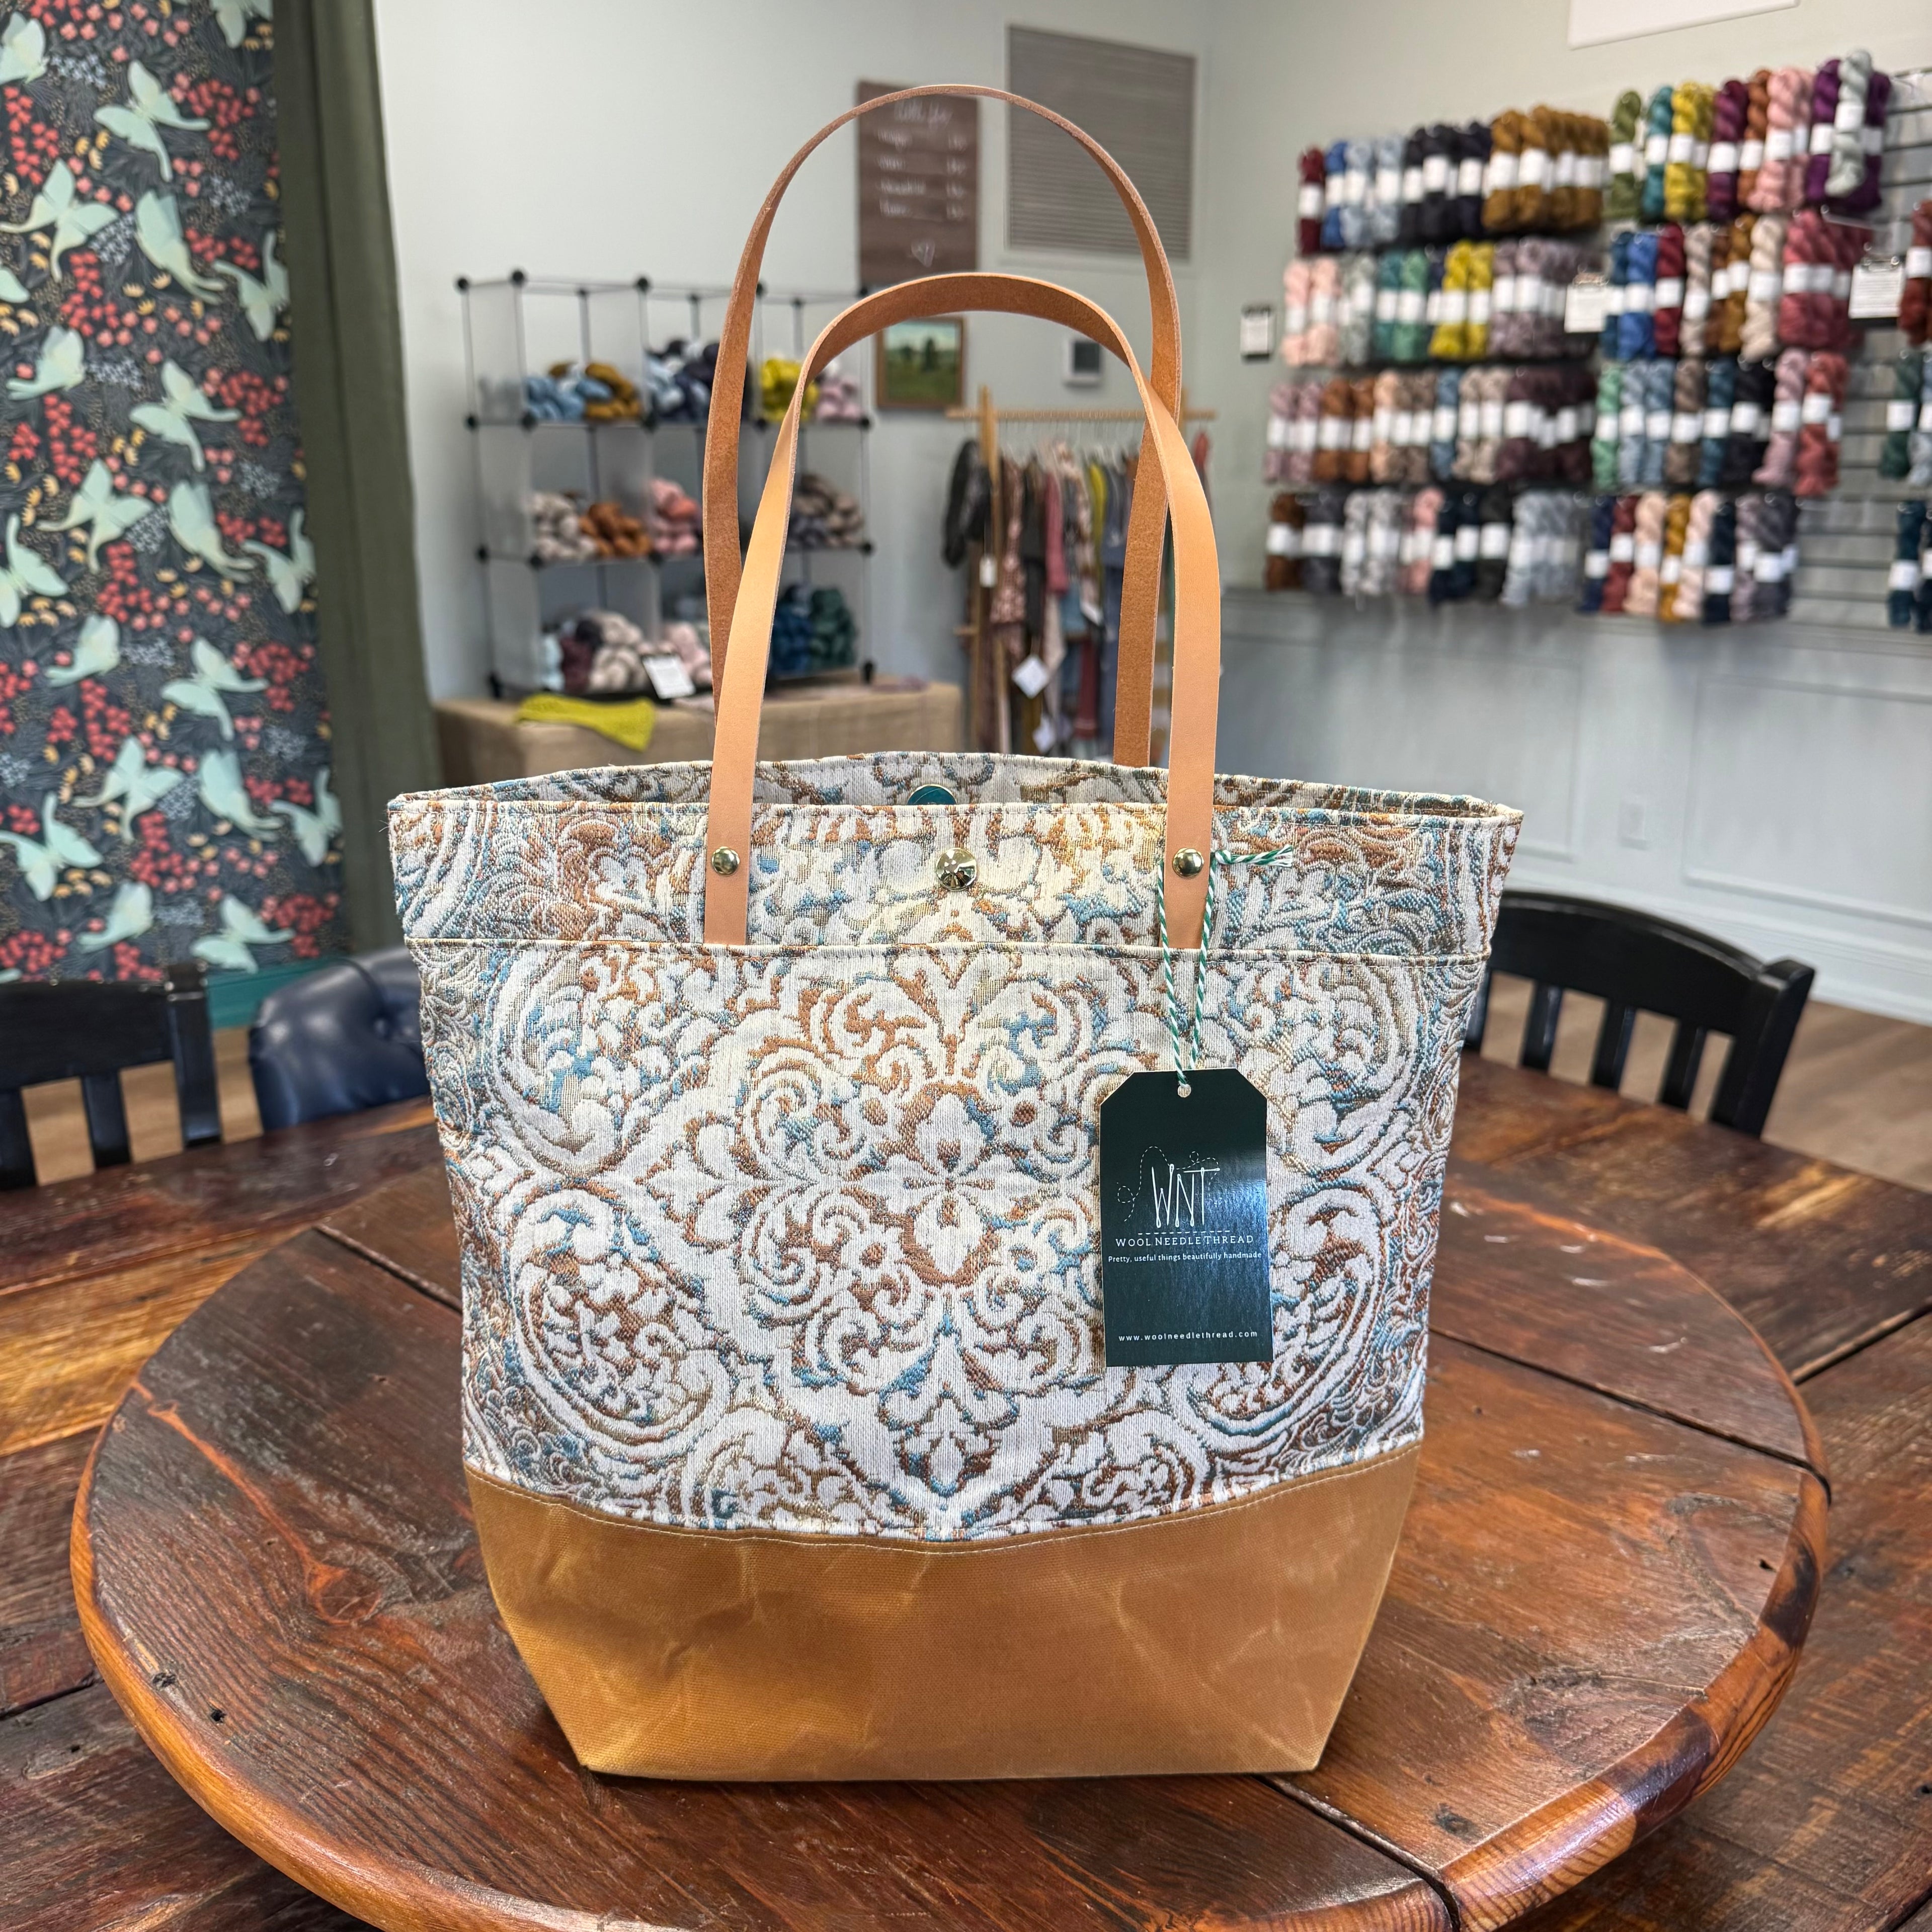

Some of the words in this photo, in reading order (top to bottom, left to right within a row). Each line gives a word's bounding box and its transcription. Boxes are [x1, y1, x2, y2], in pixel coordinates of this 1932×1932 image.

[1152, 1163, 1221, 1229] WNT
[1115, 1238, 1151, 1247] WOOL
[1155, 1236, 1201, 1246] NEEDLE
[1203, 1235, 1254, 1245] THREAD
[1108, 1255, 1132, 1263] Pretty,
[1158, 1253, 1181, 1262] things
[1182, 1252, 1222, 1261] beautifully
[1224, 1251, 1262, 1259] handmade
[1118, 1331, 1258, 1342] www.woolneedlethread.com
